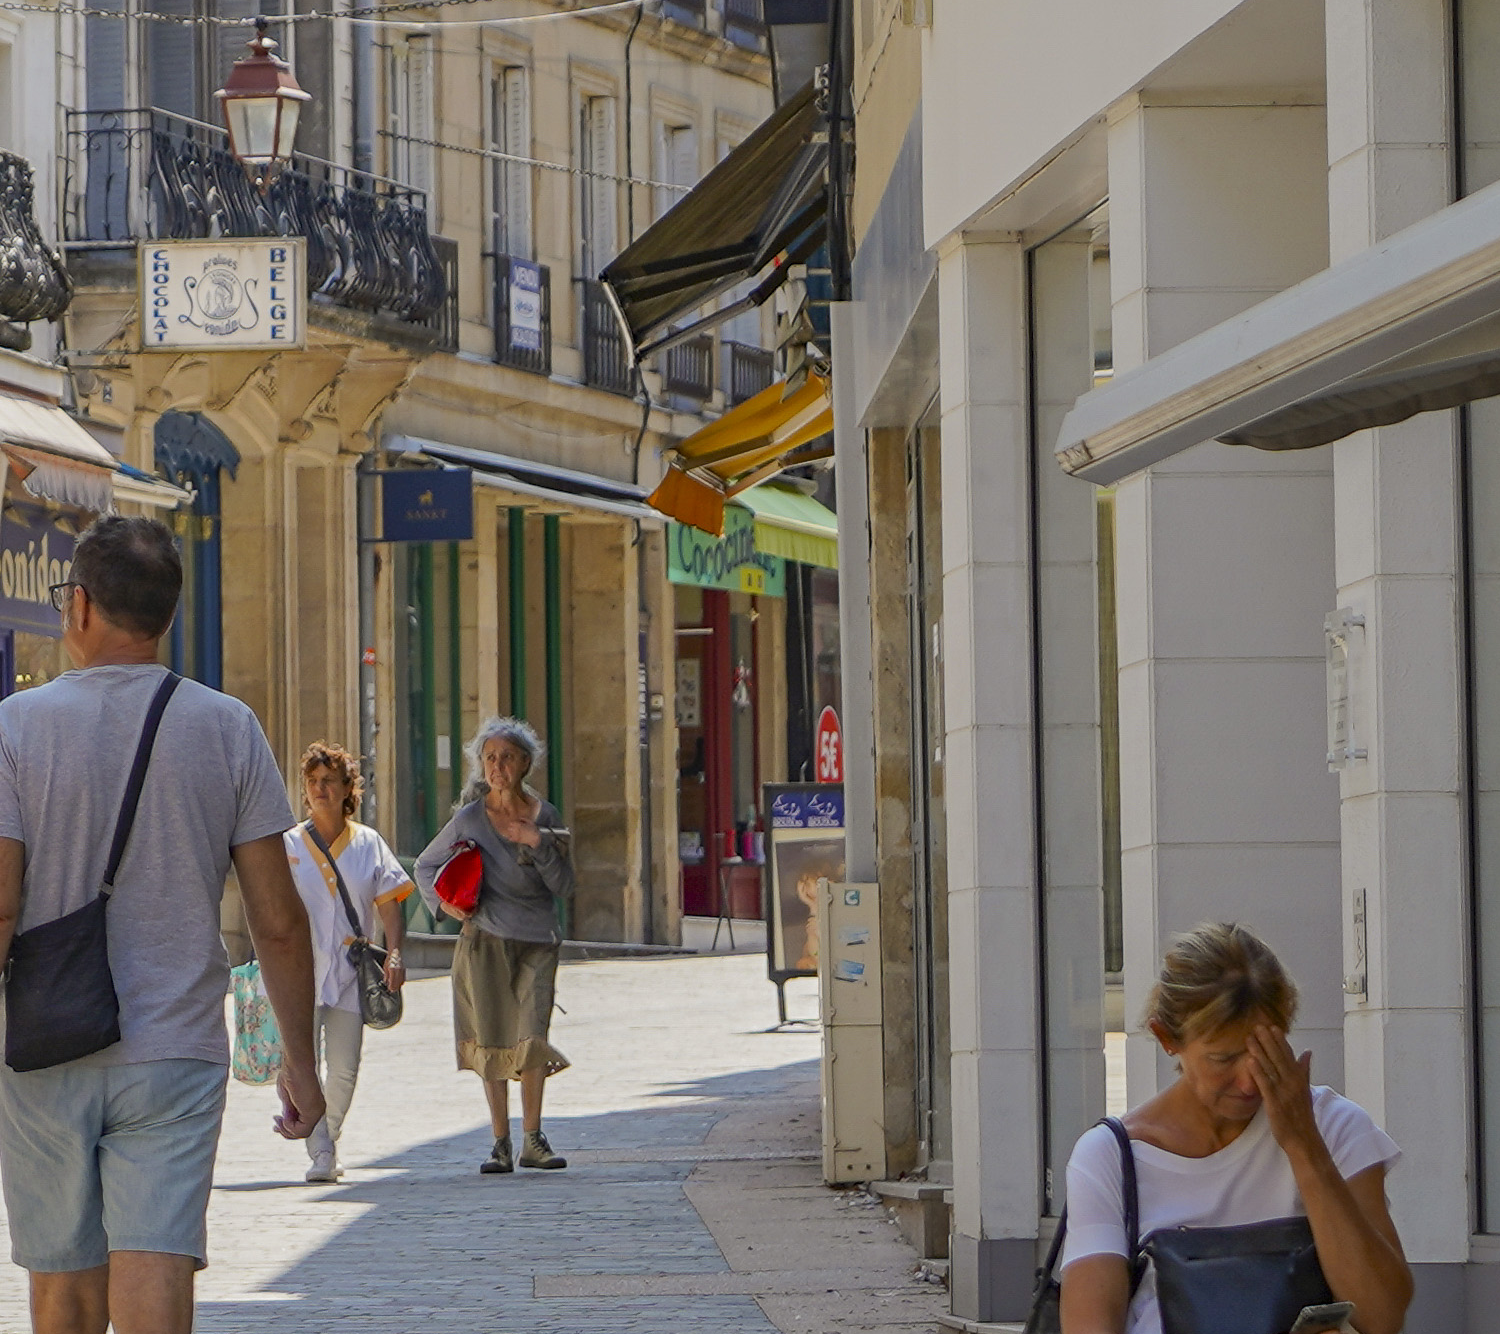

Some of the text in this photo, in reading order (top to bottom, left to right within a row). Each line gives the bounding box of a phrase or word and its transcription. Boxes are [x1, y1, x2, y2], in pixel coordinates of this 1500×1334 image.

[152, 249, 170, 343] CHOCOLAT
[269, 247, 288, 341] BELGE
[820, 729, 841, 780] 5€
